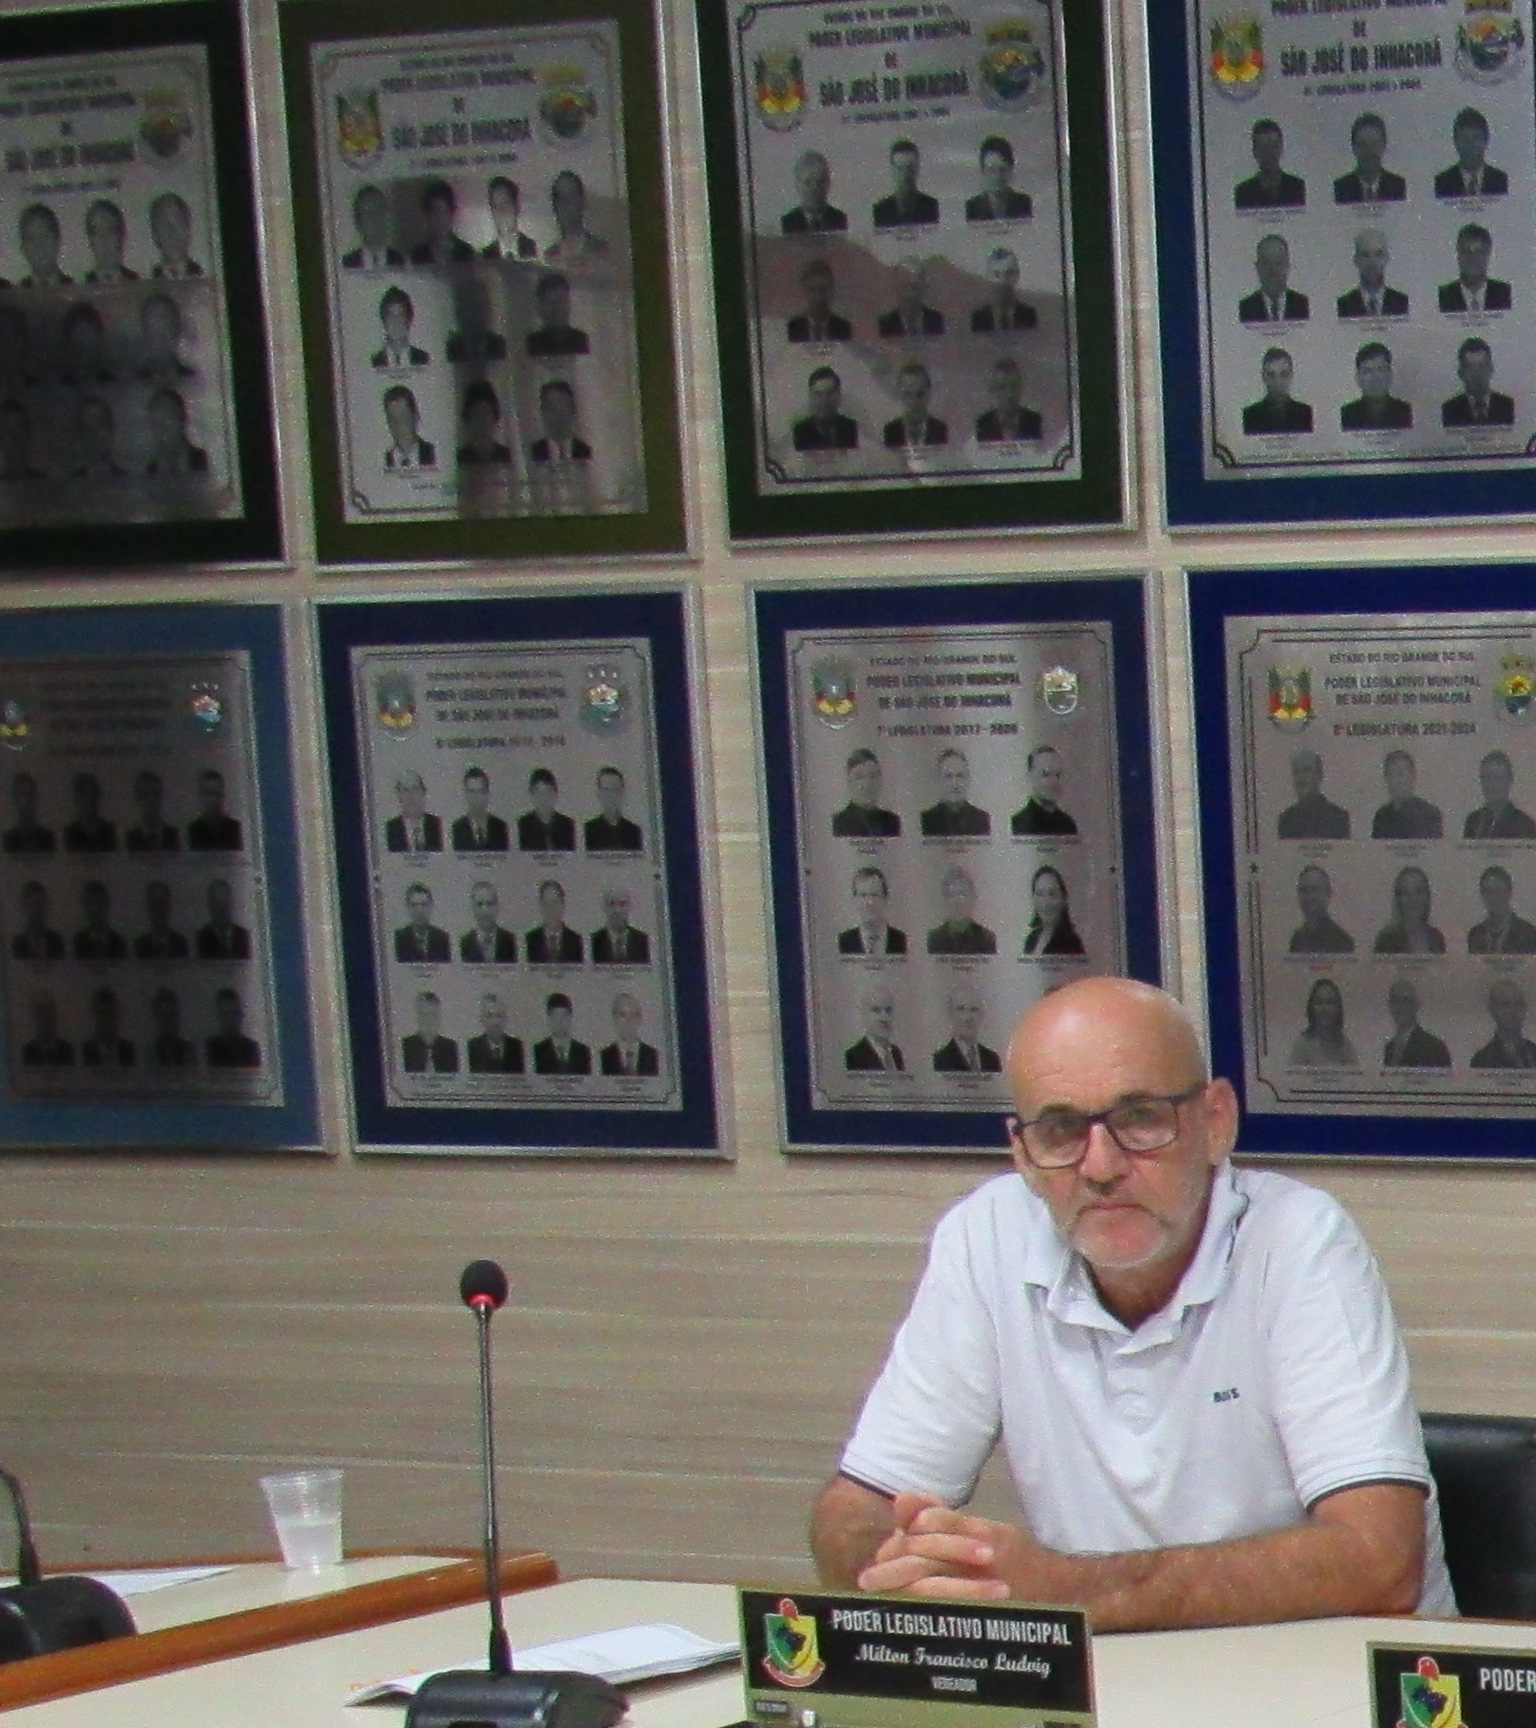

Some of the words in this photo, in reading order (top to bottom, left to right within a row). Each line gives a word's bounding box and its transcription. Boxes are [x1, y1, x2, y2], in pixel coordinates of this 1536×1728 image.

[830, 1607, 884, 1634] PODER
[884, 1611, 983, 1641] LEGISLATIVO
[984, 1617, 1073, 1647] MUNICIPAL
[854, 1643, 911, 1666] Milton
[913, 1646, 989, 1670] Francisco
[930, 1675, 979, 1693] VEREADOR
